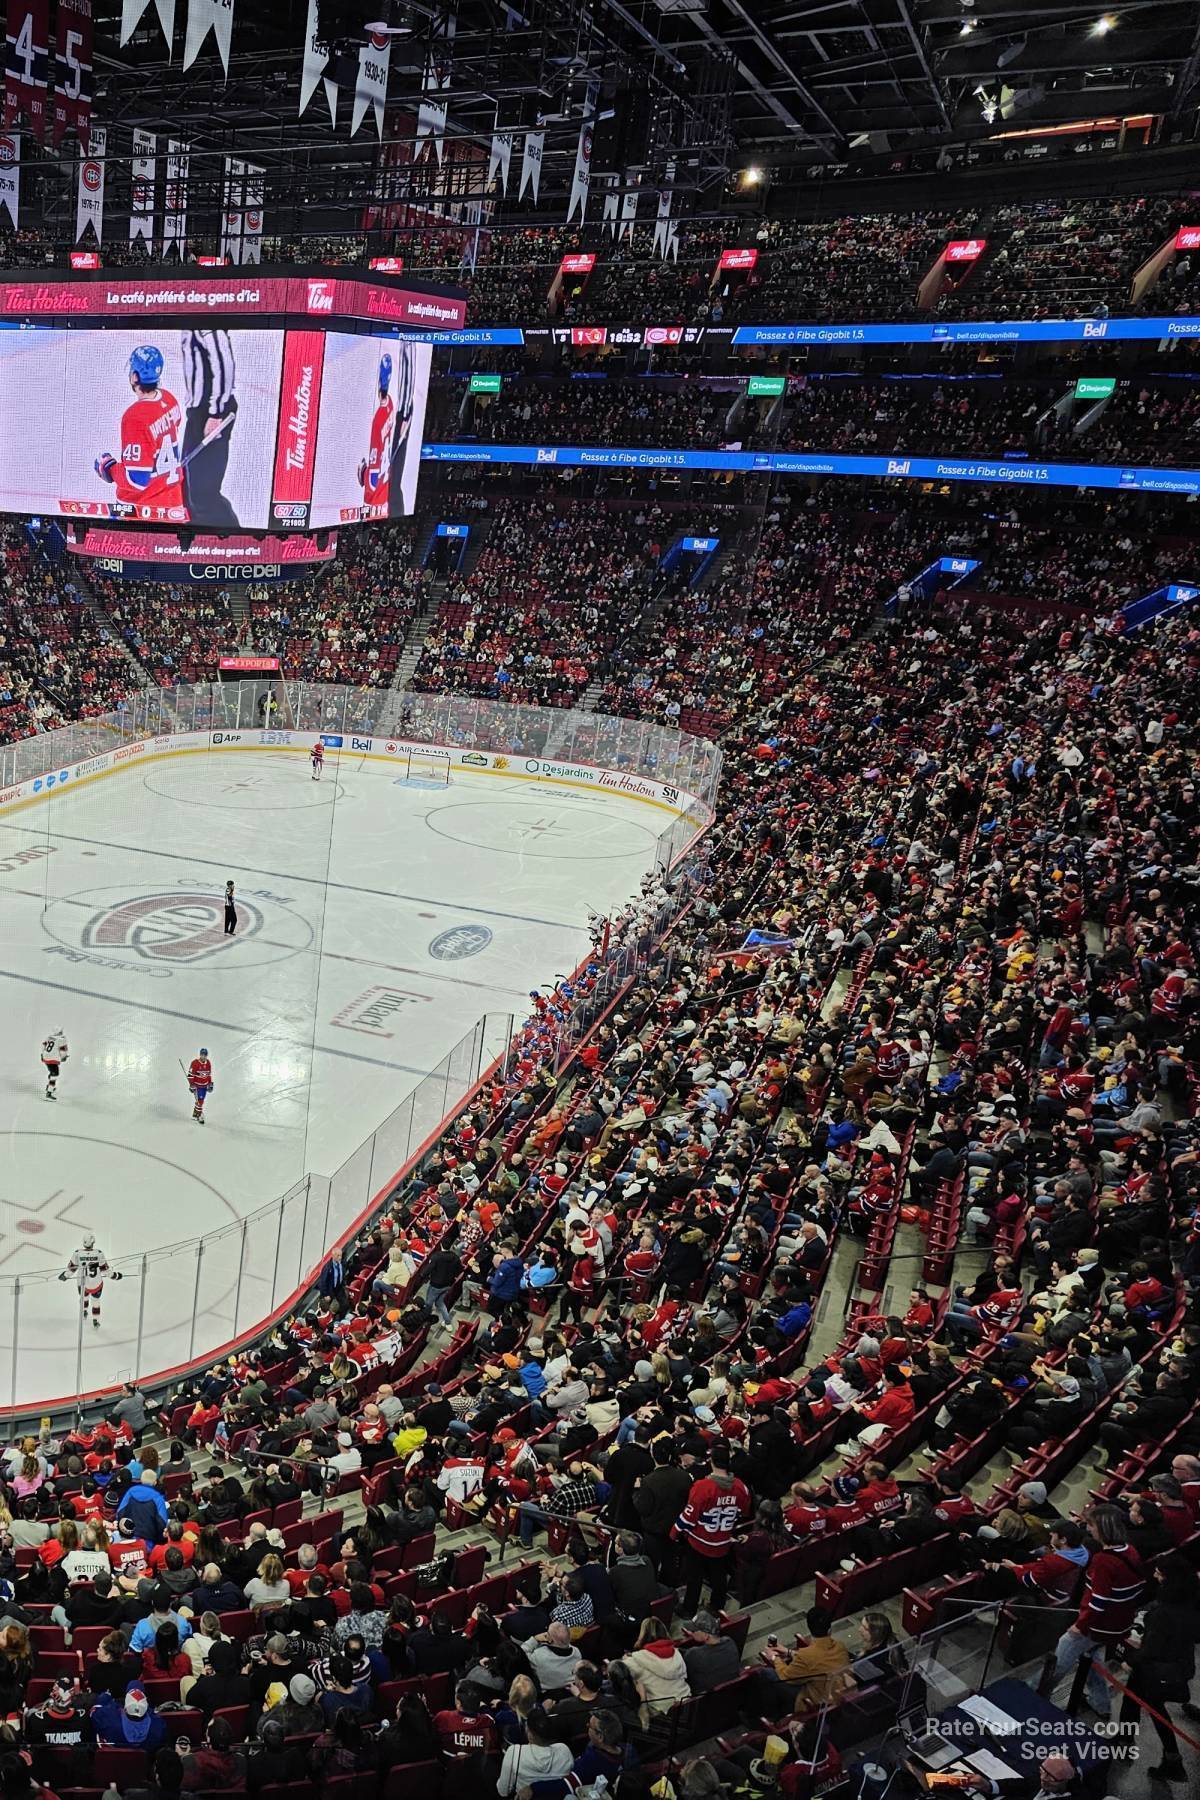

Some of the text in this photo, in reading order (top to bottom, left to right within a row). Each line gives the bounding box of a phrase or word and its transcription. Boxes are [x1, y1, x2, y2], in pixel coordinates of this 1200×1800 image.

[15, 13, 35, 86] 4
[65, 29, 82, 100] 5
[363, 60, 387, 86] 1930-31
[950, 247, 981, 258] Molson
[5, 288, 89, 310] Tim Hortons
[107, 290, 235, 307] Le café préféré des gens
[308, 283, 333, 310] Tim
[669, 332, 678, 342] 0
[756, 330, 851, 342] Passez Fibe Gigabit
[1083, 323, 1106, 337] Bell
[433, 333, 480, 344] Fibe Gigabit
[610, 333, 641, 343] 18:52
[685, 334, 694, 342] 10
[758, 383, 781, 391] Desjardins
[1086, 384, 1112, 393] Desjardins
[286, 365, 313, 472] Tim Hortons
[123, 444, 141, 462] 49
[537, 449, 557, 463] Bell
[581, 452, 672, 465] Passez Fibe Gigabit
[888, 460, 910, 474] Bell
[937, 464, 1032, 481] Passez Fibe Gigabit
[141, 504, 150, 516] 0
[446, 527, 459, 535] Bell
[84, 534, 102, 552] Tim
[101, 535, 146, 556] Hortons
[155, 545, 244, 557] Le café des gens
[282, 541, 301, 558] Tim
[694, 540, 708, 549] Bell
[951, 561, 967, 571] Bell
[258, 731, 291, 745] IBM
[352, 738, 372, 751] Bell
[129, 743, 145, 757] pizza
[543, 763, 594, 780] Desjardins
[598, 771, 618, 788] Tim
[619, 776, 655, 798] Hortons
[662, 786, 679, 801] SN
[351, 993, 418, 1029] intact
[987, 1302, 1000, 1313] 26
[703, 1506, 738, 1532] 32
[45, 1731, 82, 1744] TKACHUK
[454, 1732, 484, 1747] LÉPINE
